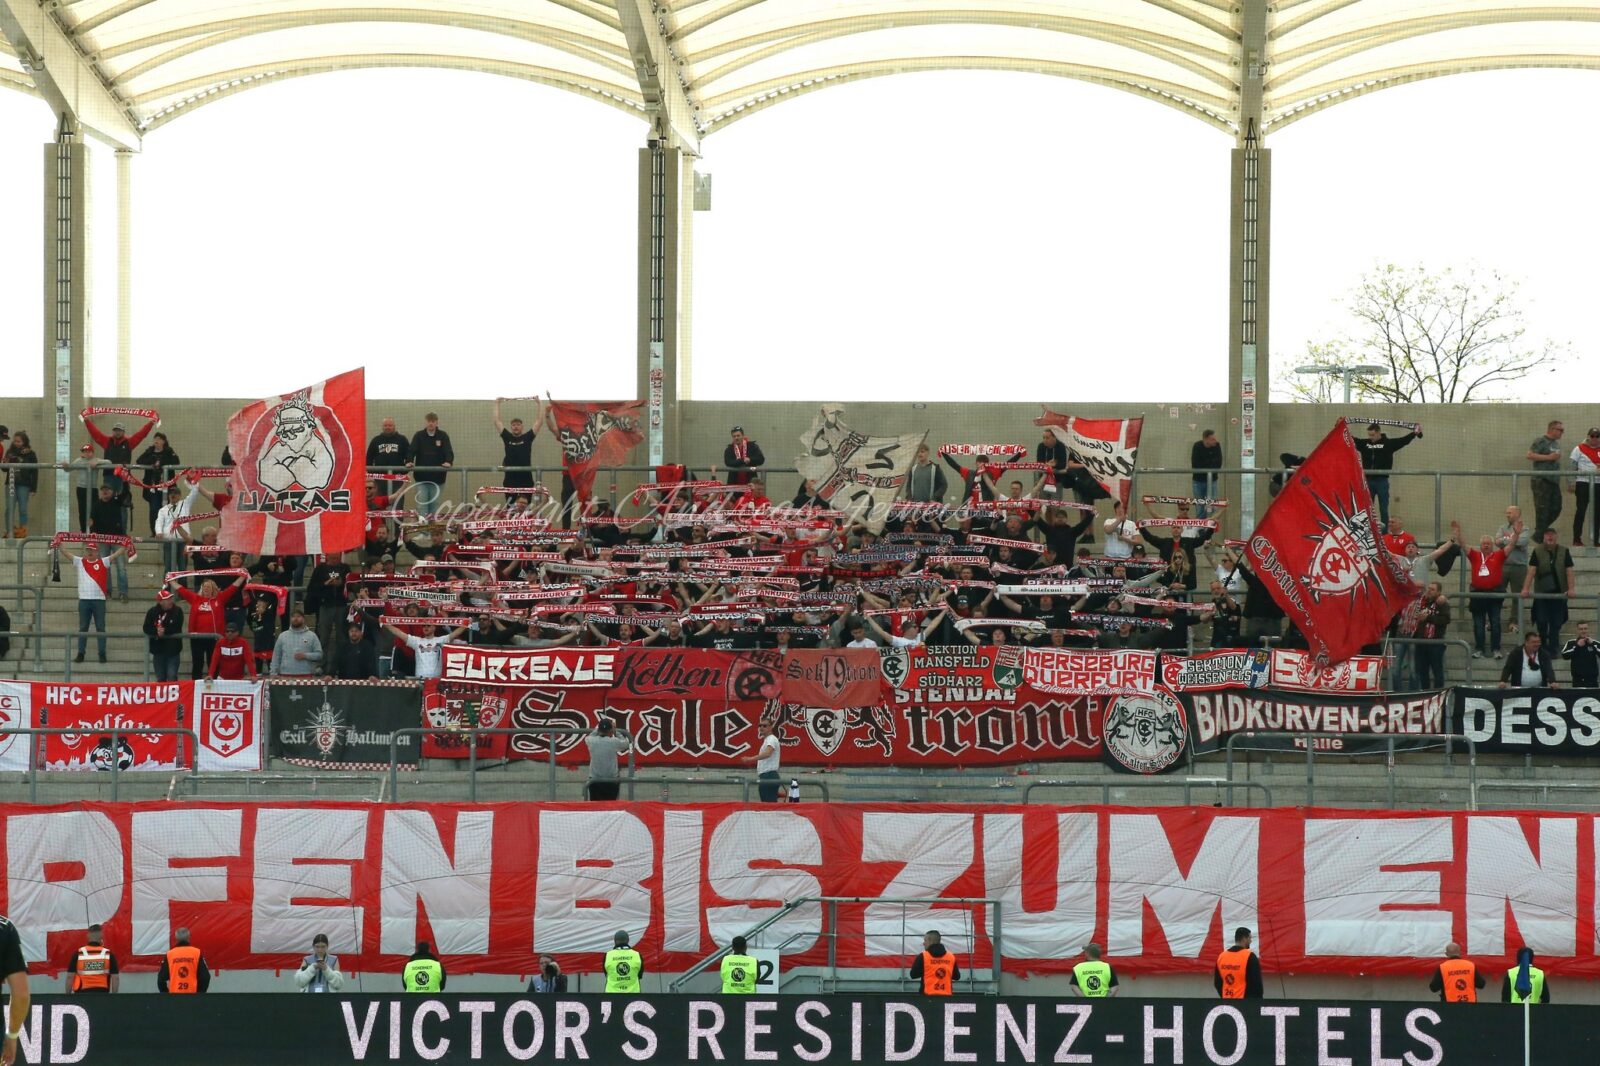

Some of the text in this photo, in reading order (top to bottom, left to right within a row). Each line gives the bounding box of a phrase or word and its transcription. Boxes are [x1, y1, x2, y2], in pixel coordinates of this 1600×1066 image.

[237, 490, 350, 512] ULTRAS
[404, 590, 417, 598] ALLE
[927, 645, 978, 655] SEKTION
[446, 652, 615, 681] SURREALE
[913, 656, 990, 669] MANSFELD
[1187, 655, 1246, 673] SEKTION
[612, 651, 725, 696] Köthen
[919, 671, 983, 687] SÜDHARZ
[1178, 669, 1252, 685] WEISSENFELS
[46, 686, 82, 705] HFC
[97, 684, 180, 705] FANCLUB
[895, 687, 1017, 704] STENDAL
[205, 696, 248, 710] HFC
[1137, 708, 1154, 718] HFC
[1192, 689, 1447, 743] BADKURVEN-CREW
[1464, 697, 1600, 747] DESS
[279, 729, 411, 747] Exil Hallunen
[1293, 737, 1343, 750] Halle
[6, 808, 1600, 963] PFEN BIS ZUM EN
[177, 982, 189, 990] 29
[934, 983, 945, 991] 24
[1225, 988, 1234, 996] 26
[341, 1001, 1444, 1066] VICTOR'S RESIDENZ-HOTELS
